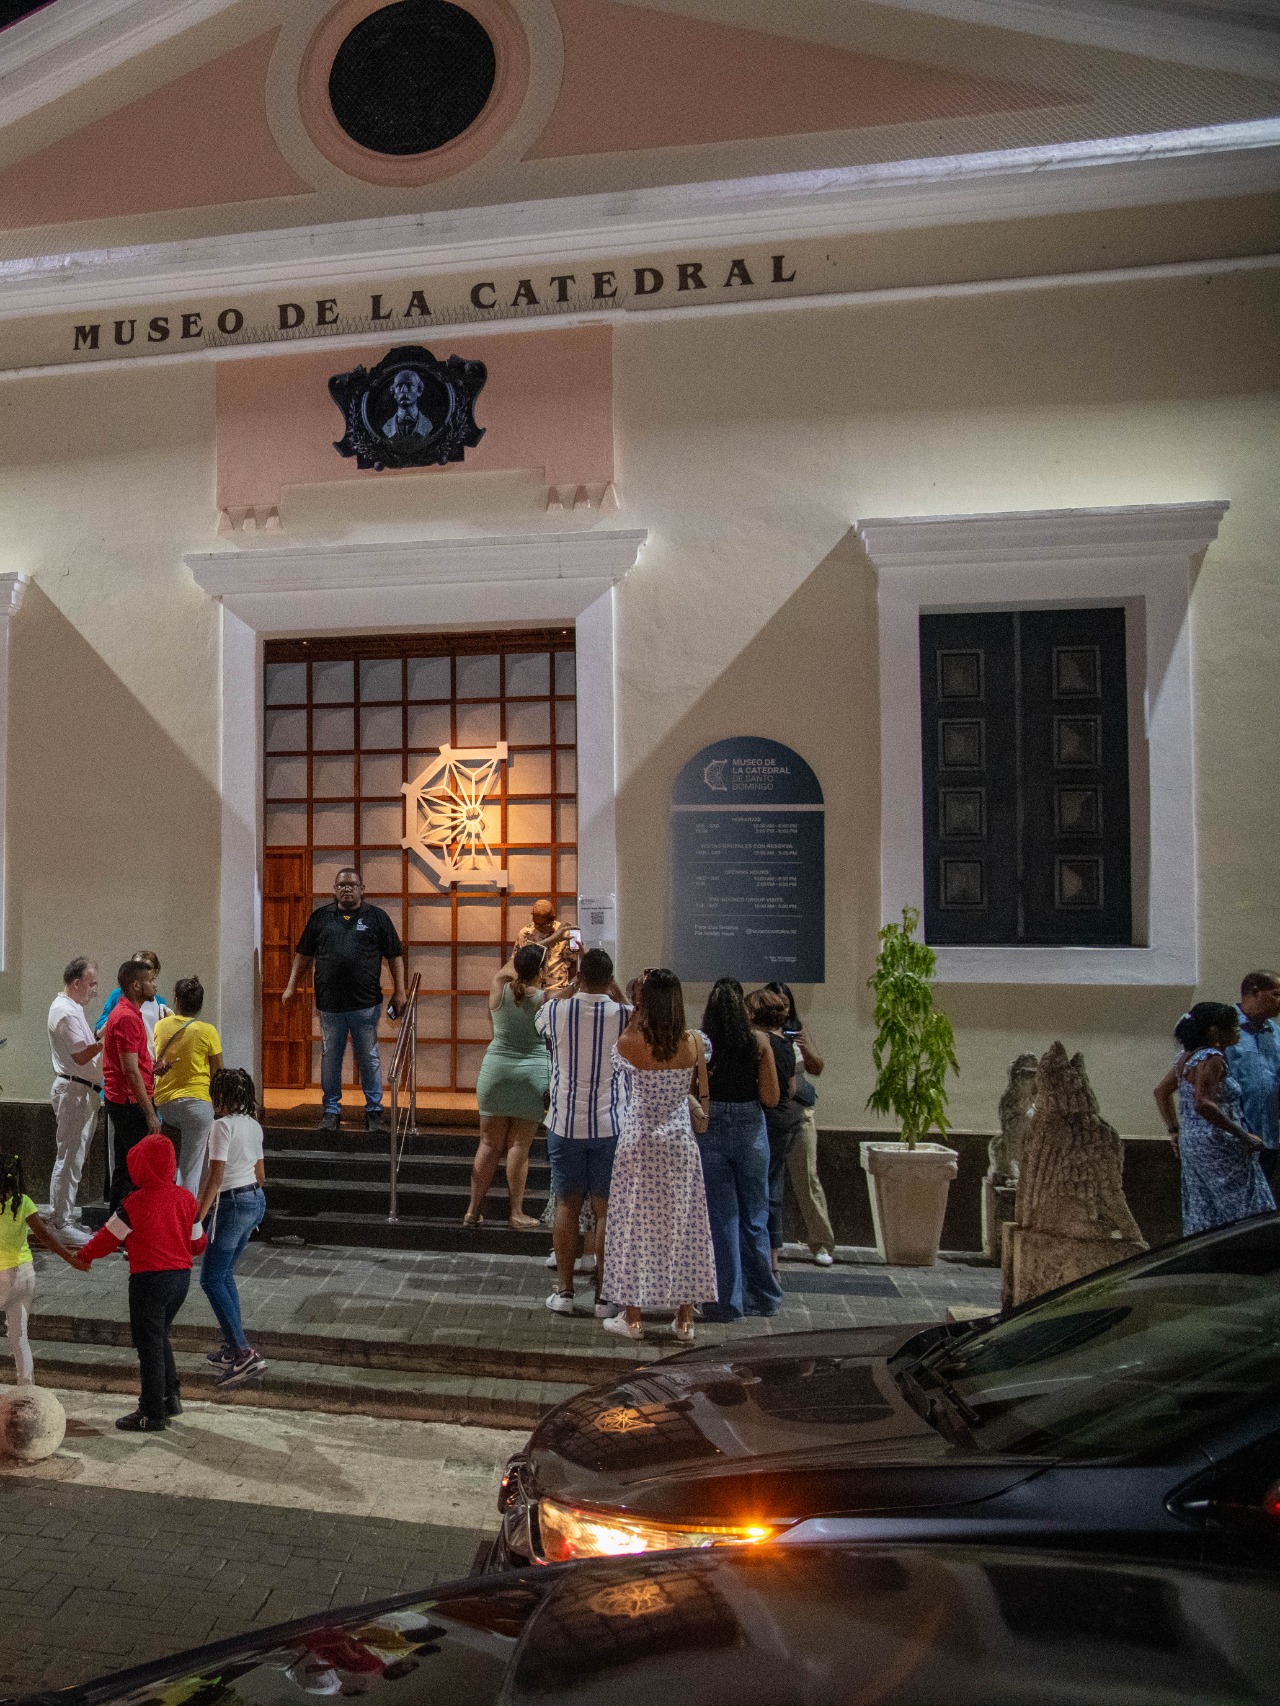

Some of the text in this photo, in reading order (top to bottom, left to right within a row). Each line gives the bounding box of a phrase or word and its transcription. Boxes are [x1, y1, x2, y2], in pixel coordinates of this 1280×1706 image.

[72, 254, 798, 351] MUSEO DE LA CATEDRAL
[745, 767, 791, 775] CATEDRAL
[745, 775, 774, 783] SANTO
[732, 783, 774, 791] DOMINGO
